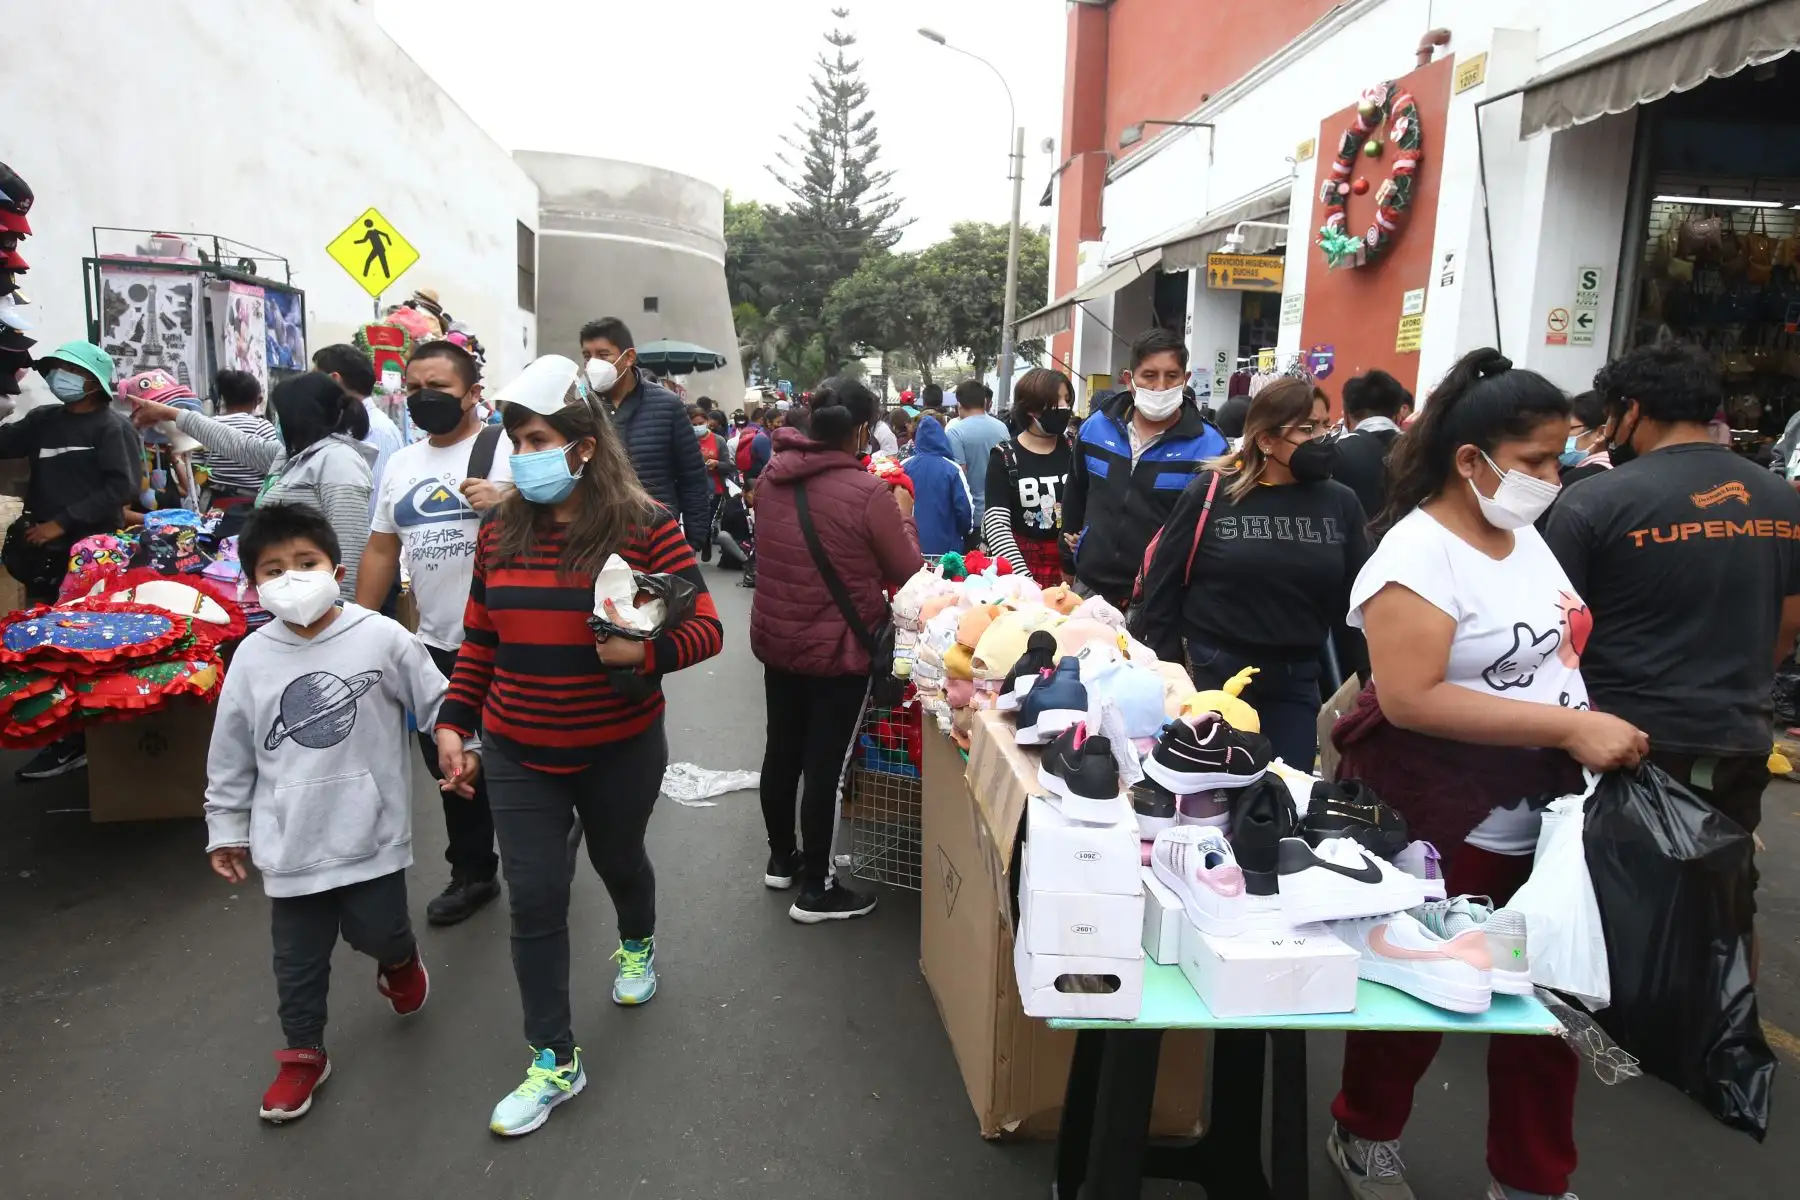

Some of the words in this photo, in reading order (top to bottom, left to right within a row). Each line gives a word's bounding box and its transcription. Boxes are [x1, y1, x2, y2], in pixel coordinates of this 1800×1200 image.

[1210, 256, 1244, 266] SERVICIOS
[1233, 267, 1259, 276] DUCHAS
[1582, 270, 1597, 290] S
[1402, 317, 1421, 328] AFORO
[1218, 351, 1226, 363] S
[1018, 473, 1068, 508] BT
[1214, 515, 1346, 544] CHILL
